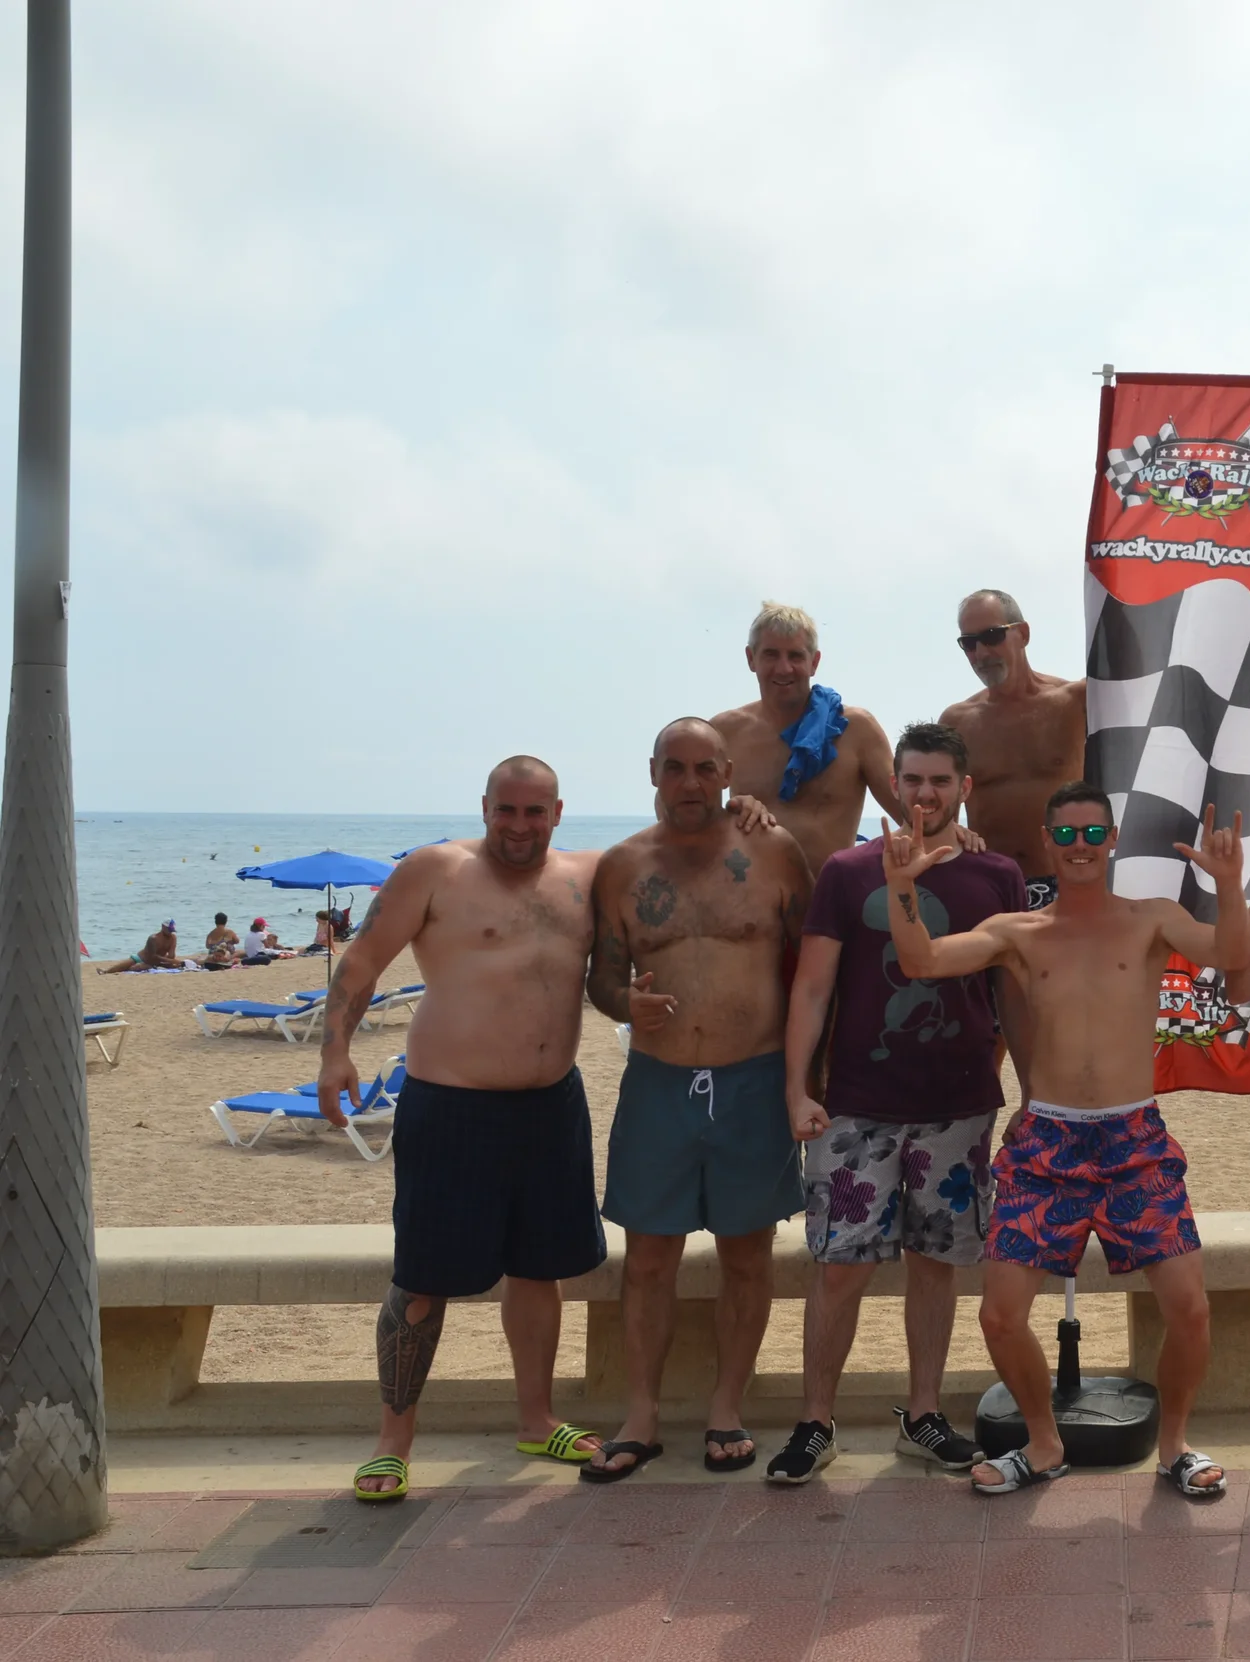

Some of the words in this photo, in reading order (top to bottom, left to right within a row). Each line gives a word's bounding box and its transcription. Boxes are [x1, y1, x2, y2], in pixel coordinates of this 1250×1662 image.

[1137, 463, 1203, 484] Wack
[1031, 1105, 1050, 1115] Calvin
[1051, 1110, 1066, 1119] Klein
[1081, 1113, 1102, 1121] Calvin
